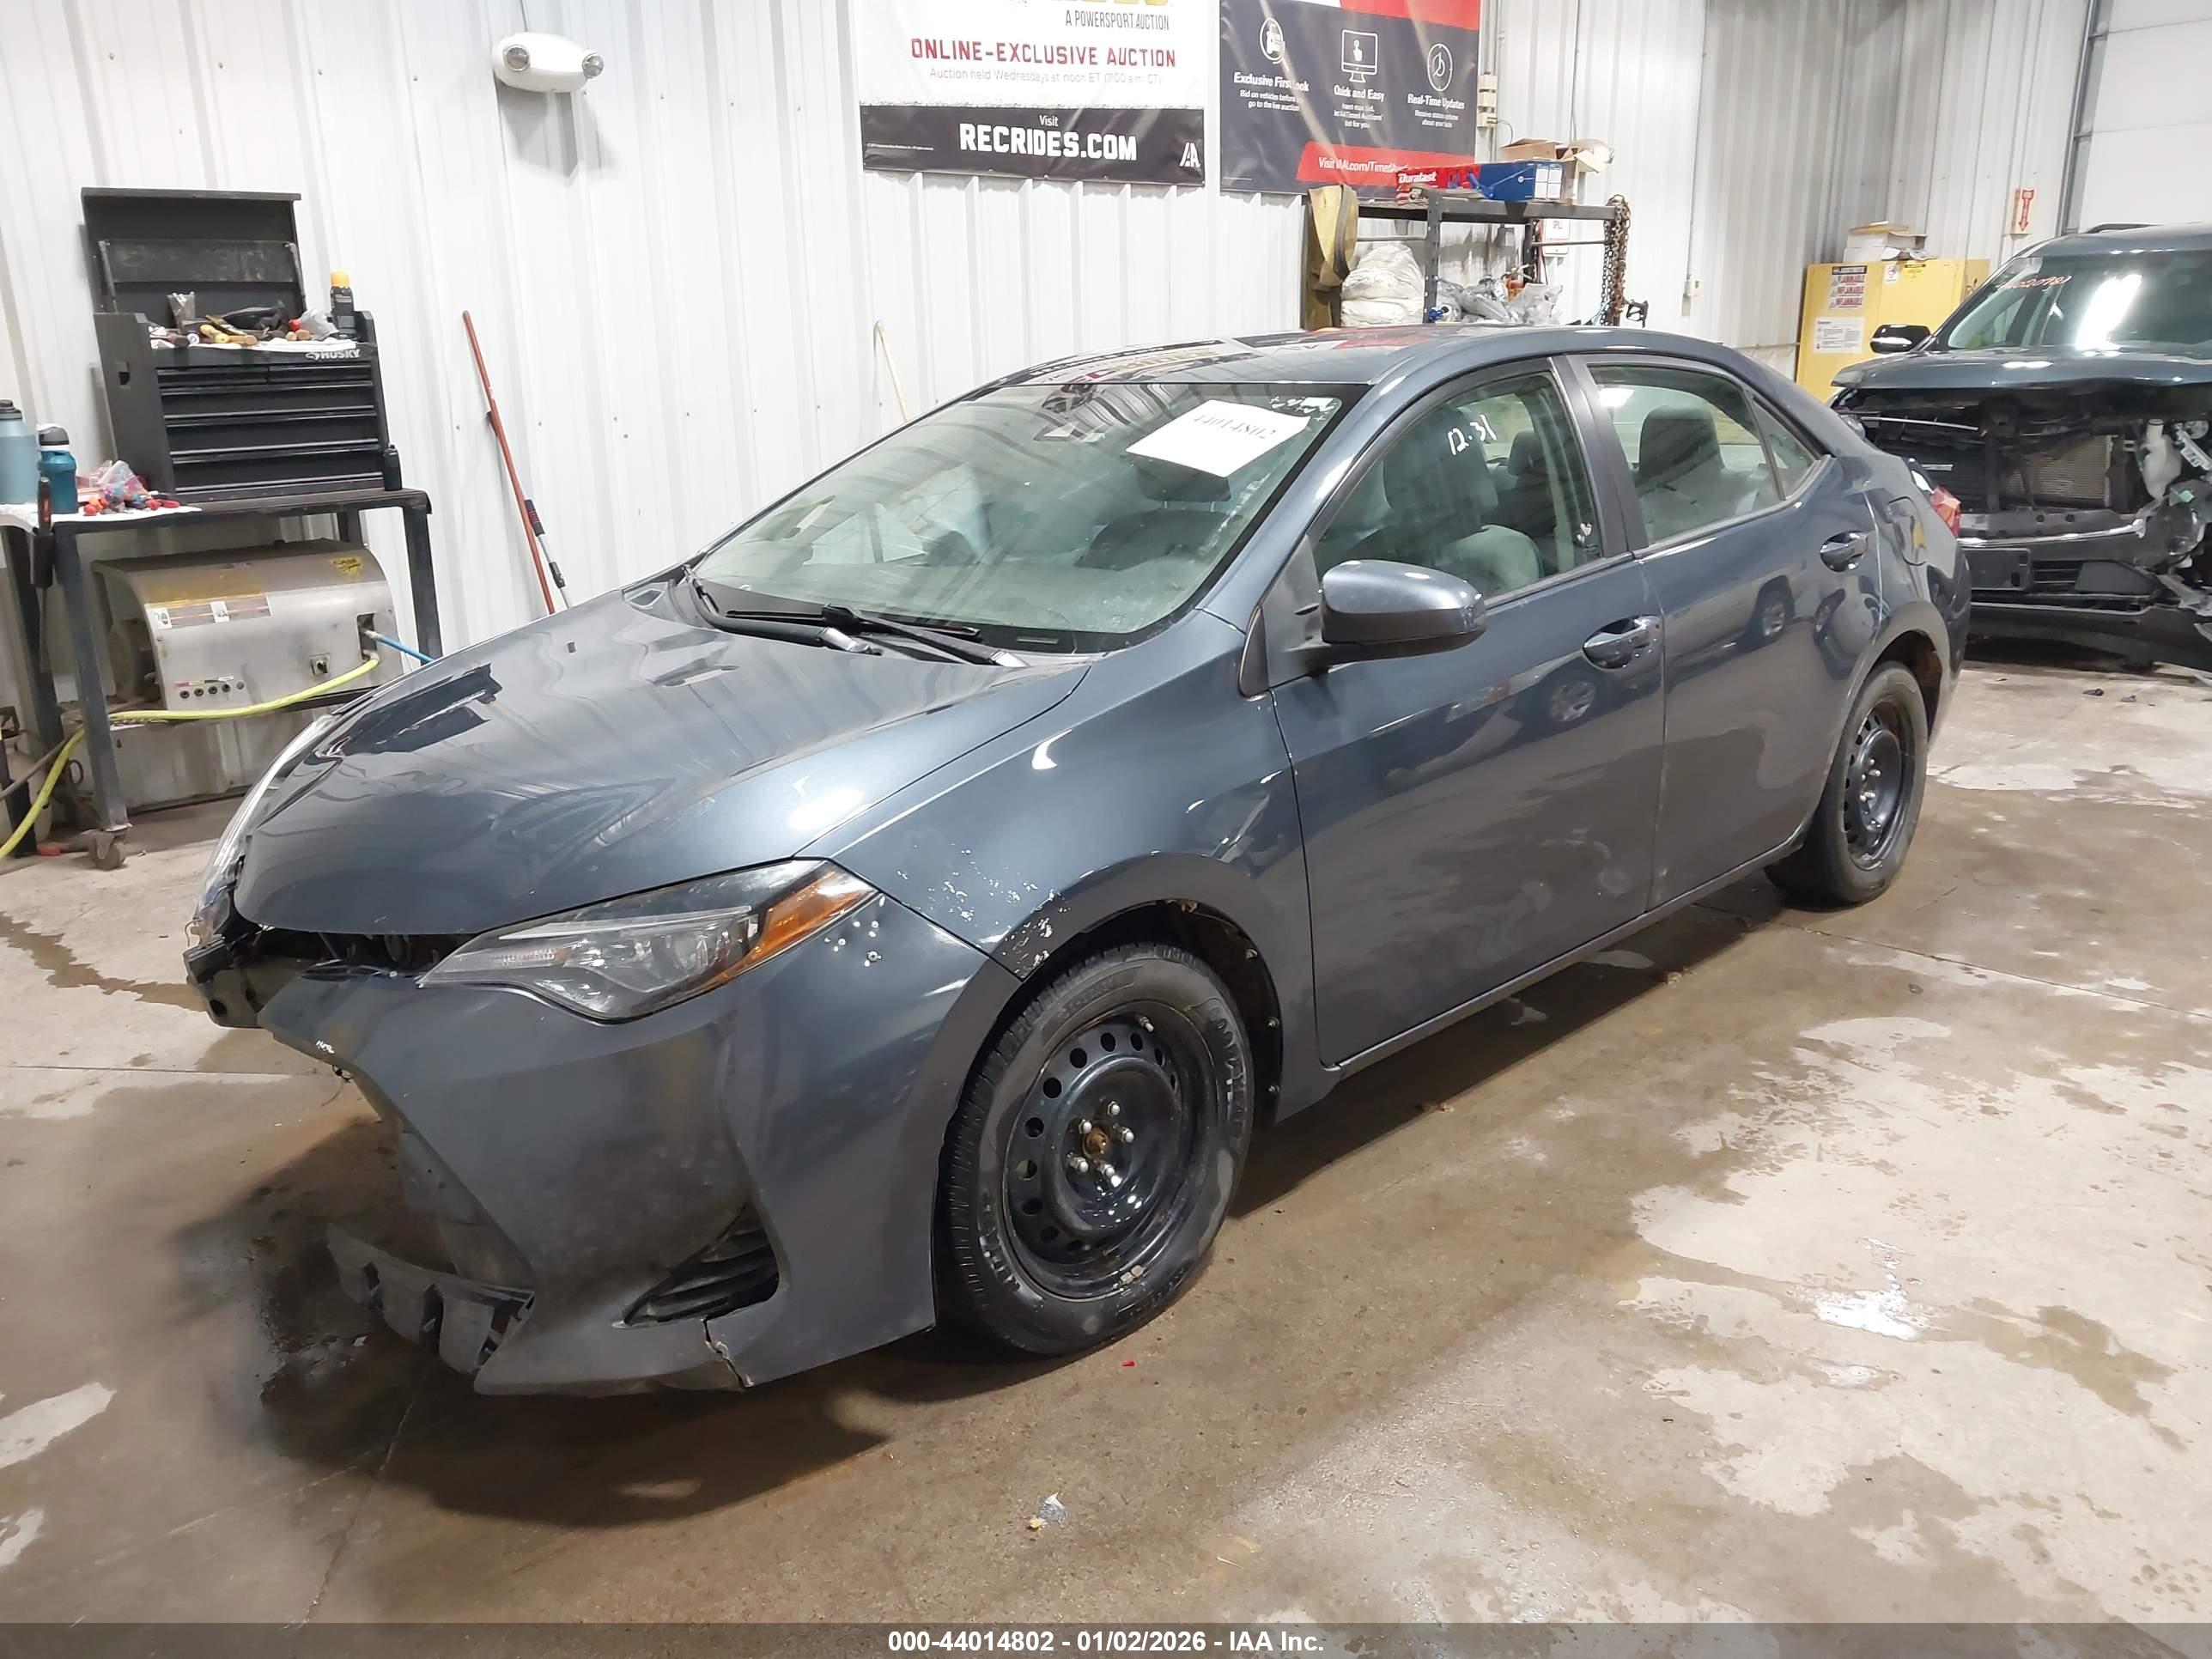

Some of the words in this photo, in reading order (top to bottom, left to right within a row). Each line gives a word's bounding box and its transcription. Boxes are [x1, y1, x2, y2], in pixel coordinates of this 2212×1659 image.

[1066, 10, 1073, 27] A
[1075, 10, 1133, 29] POWERSPORT
[1136, 14, 1170, 31] AUCTION
[911, 38, 1098, 65] ONLINE-EXCLUSIVE
[1107, 47, 1176, 67] AUCTION
[929, 68, 968, 79] Auction
[970, 69, 991, 80] held
[994, 69, 1049, 84] Wednesdays
[1050, 73, 1060, 82] at
[1063, 74, 1086, 83] noon
[1088, 72, 1101, 83] ET
[1233, 71, 1273, 87] Exclusive
[1291, 80, 1310, 92] ook
[1239, 89, 1251, 98] Bid
[1334, 84, 1351, 98] Quick
[1352, 88, 1366, 99] and
[1367, 89, 1385, 102] Easy
[1407, 93, 1442, 107] Real-Time
[1442, 97, 1465, 110] Updates
[1039, 114, 1060, 127] Visit
[959, 123, 1138, 161] RECRIDES.COM
[1319, 157, 1335, 169] Visit
[1397, 171, 1437, 183] Duralast
[320, 349, 361, 360] HUSKY
